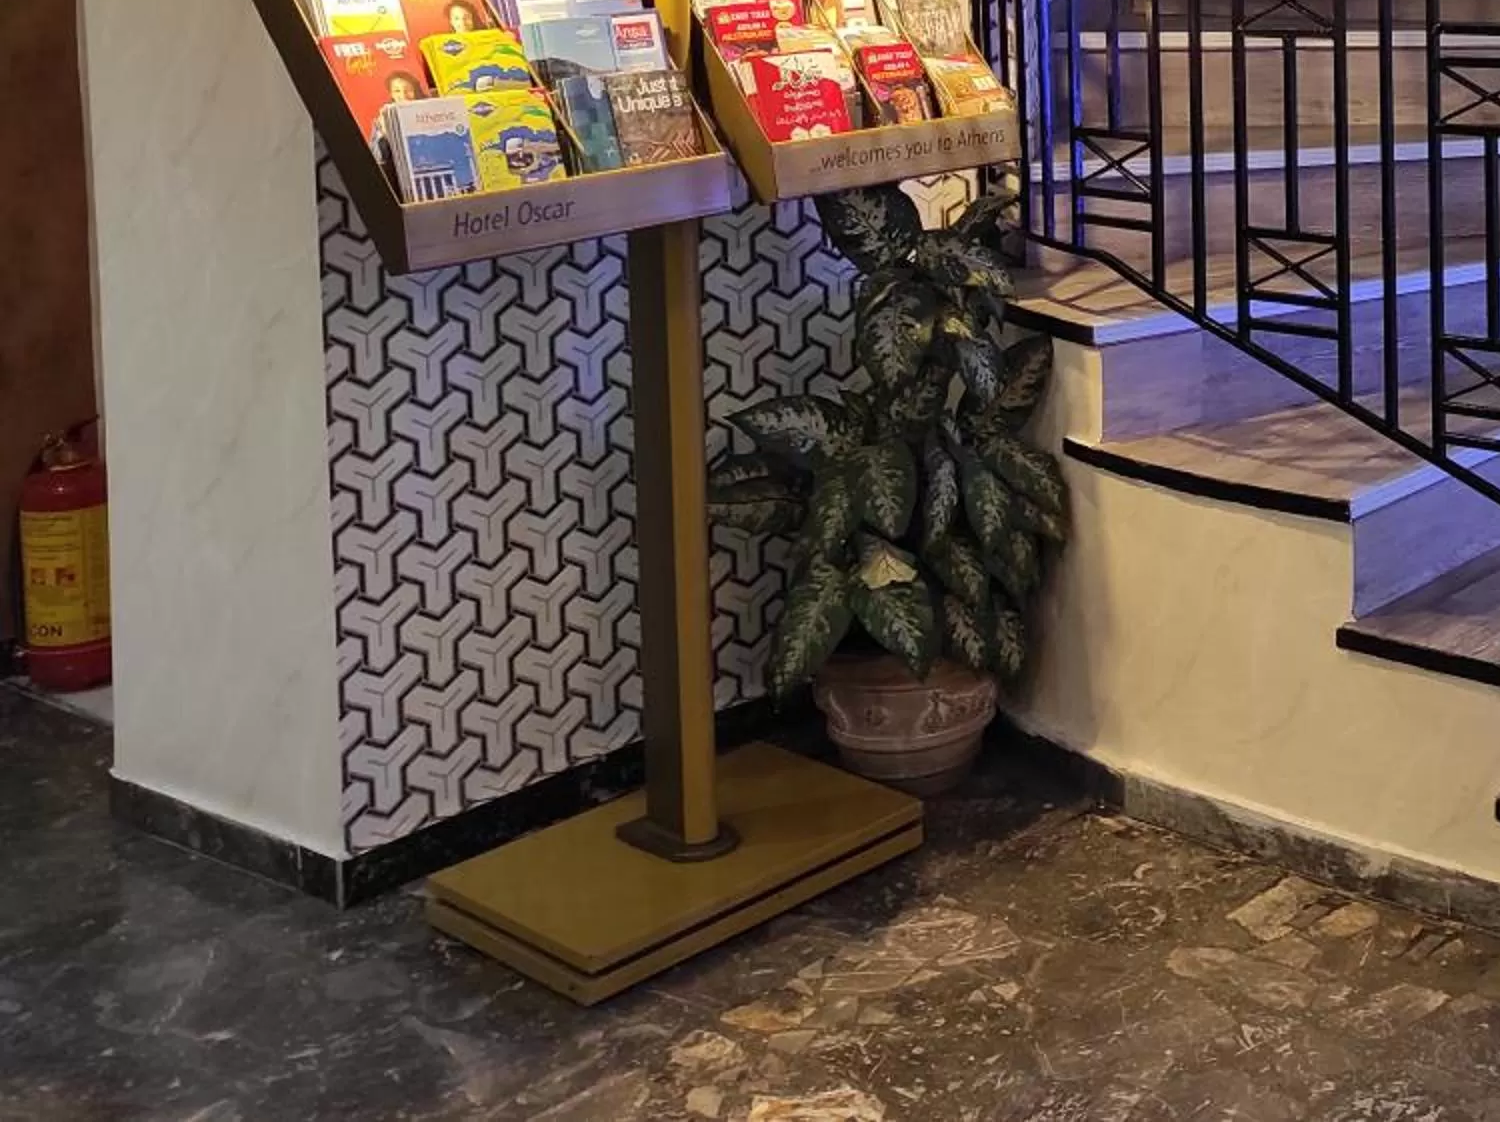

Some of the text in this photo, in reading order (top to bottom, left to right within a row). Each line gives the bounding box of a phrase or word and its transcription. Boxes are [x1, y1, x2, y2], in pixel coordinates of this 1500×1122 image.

[635, 76, 667, 95] Just
[616, 94, 671, 114] Unique
[903, 141, 933, 160] you
[937, 133, 952, 151] to
[954, 127, 1006, 147] Athens
[452, 199, 576, 239] Hotel Oscar
